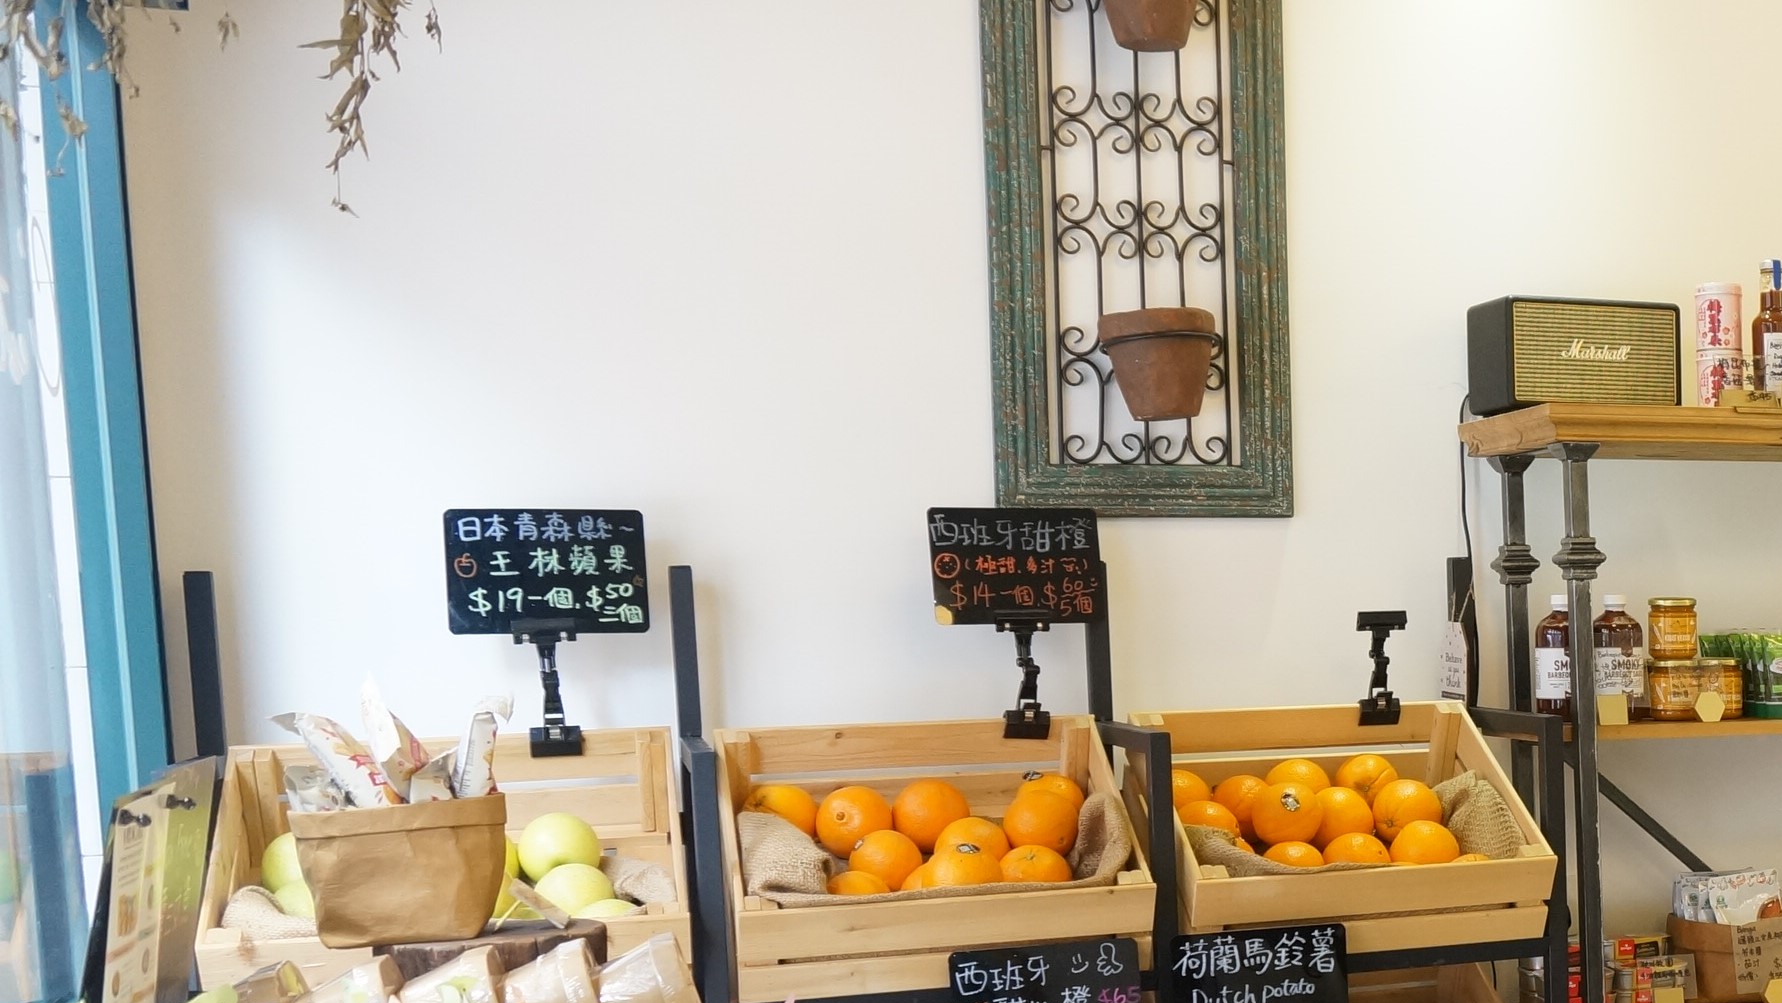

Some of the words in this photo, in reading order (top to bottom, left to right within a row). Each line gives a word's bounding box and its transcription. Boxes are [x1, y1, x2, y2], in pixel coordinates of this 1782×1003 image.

[1561, 338, 1631, 361] Marshall
[930, 514, 1092, 552] 西班牙甜橙
[489, 544, 633, 577] 王林蘋果
[1172, 927, 1335, 979] 荷蘭馬鈴薯
[955, 956, 1050, 995] 西班牙
